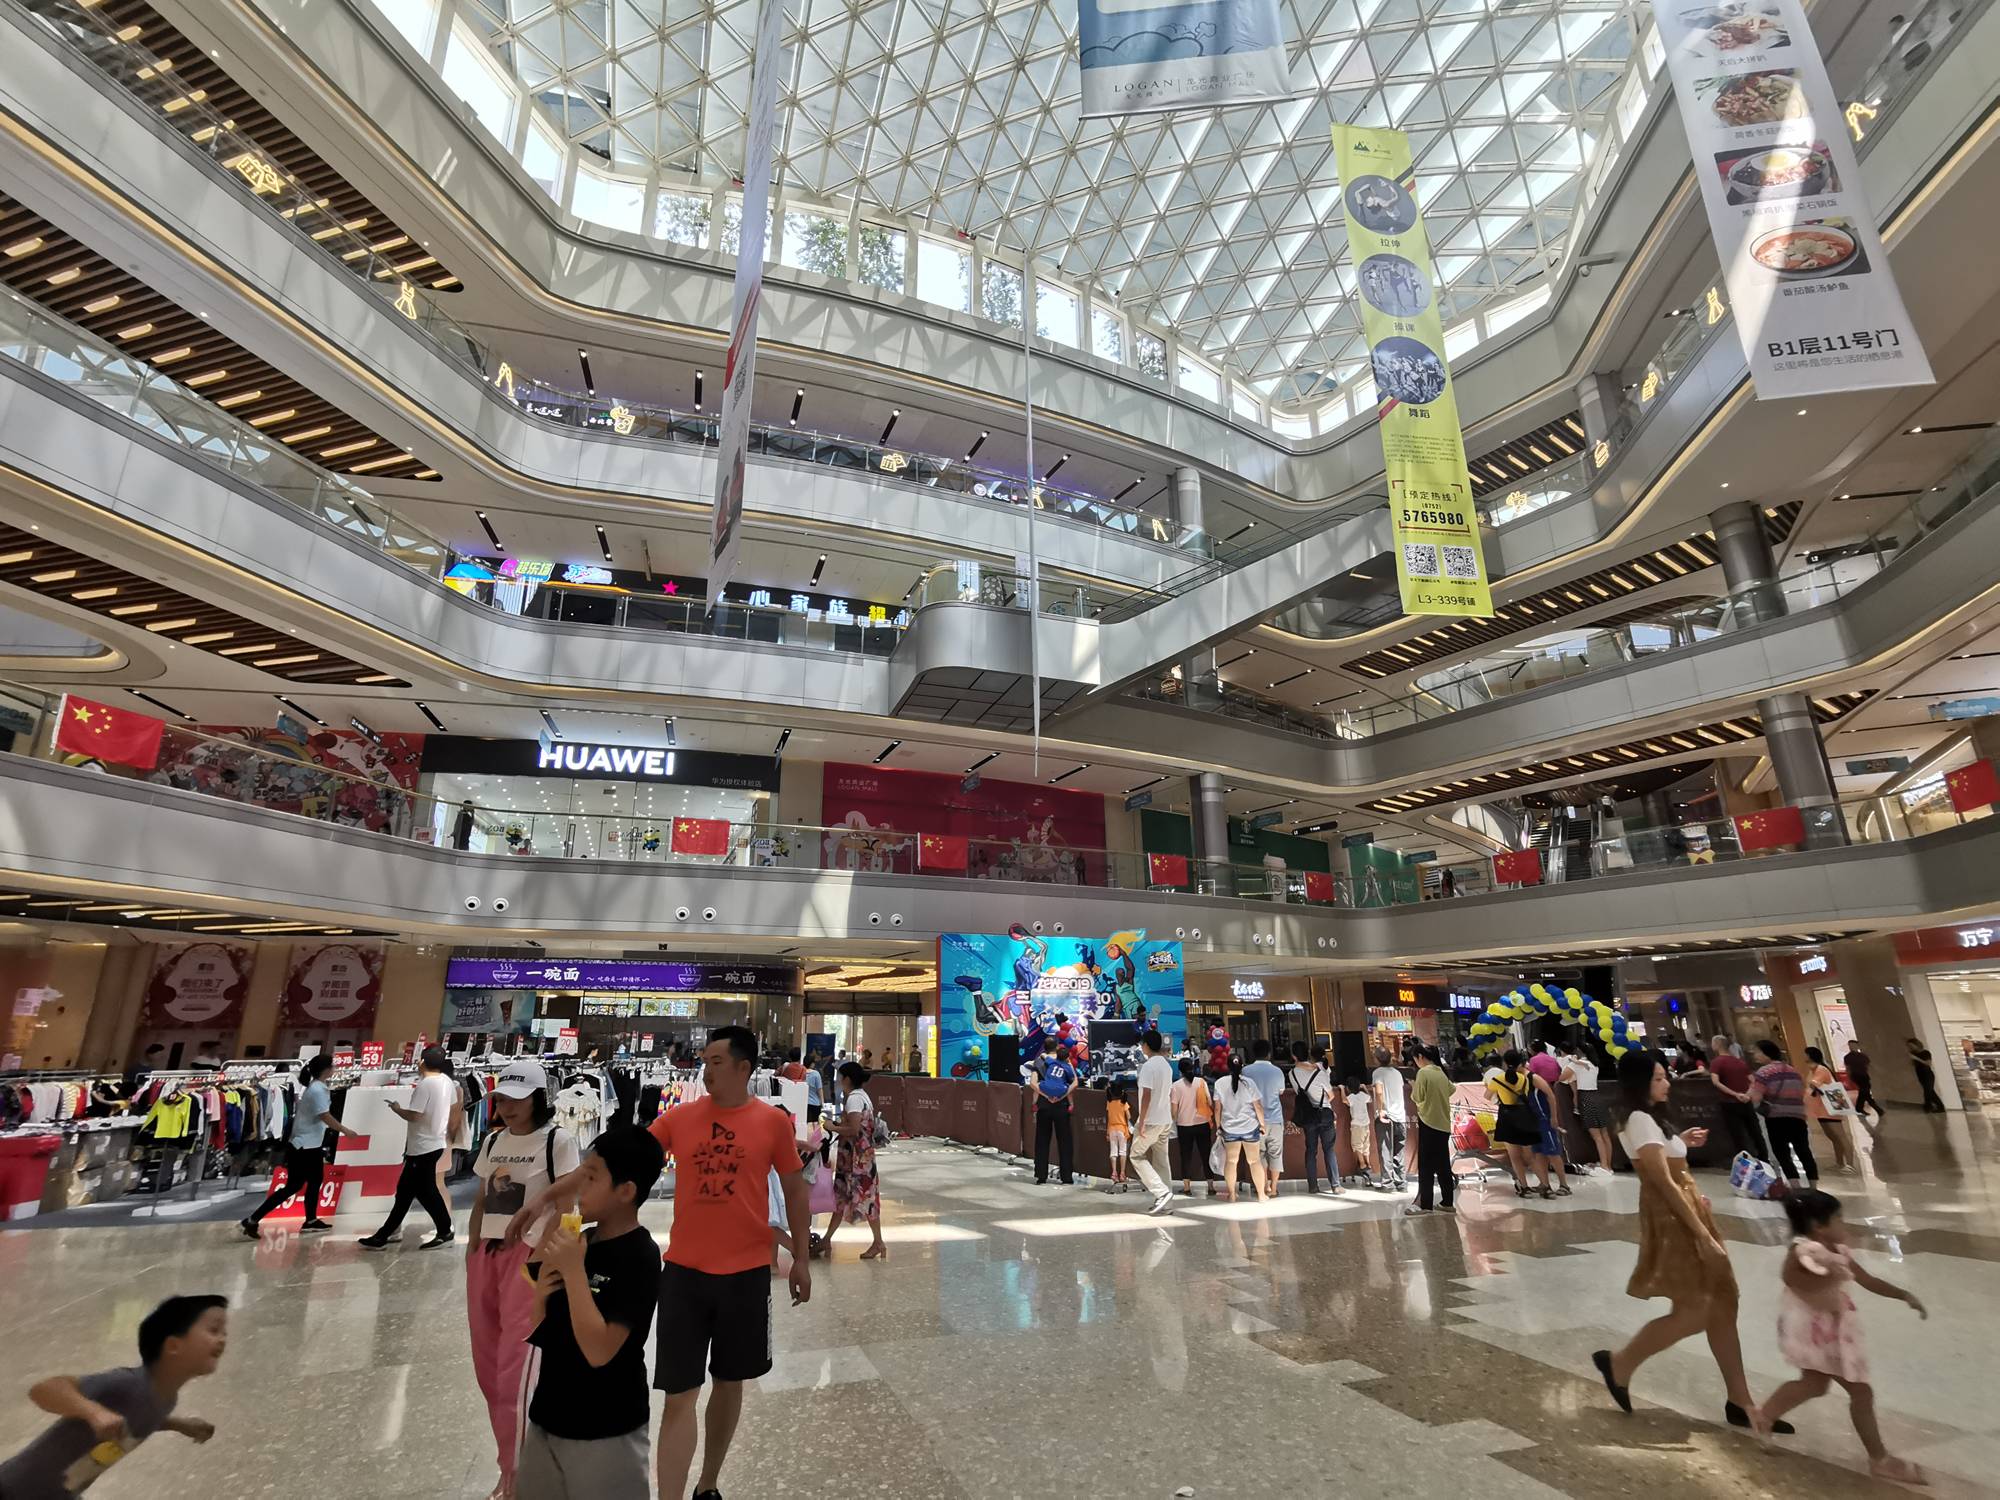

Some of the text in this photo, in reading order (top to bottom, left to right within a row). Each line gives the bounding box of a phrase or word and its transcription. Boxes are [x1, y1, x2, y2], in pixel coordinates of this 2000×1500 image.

[1114, 79, 1173, 92] LOGAN
[1768, 328, 1900, 357] B1层11号门
[1403, 509, 1464, 525] 5765980
[1417, 594, 1476, 606] L3-339号铺
[538, 745, 676, 776] HUAWEI
[1958, 927, 1994, 948] 万宁
[525, 966, 581, 982] 一碗面
[708, 971, 757, 985] 一碗面
[362, 1053, 378, 1066] 59
[1051, 1065, 1065, 1078] 10
[711, 1122, 736, 1140] Do
